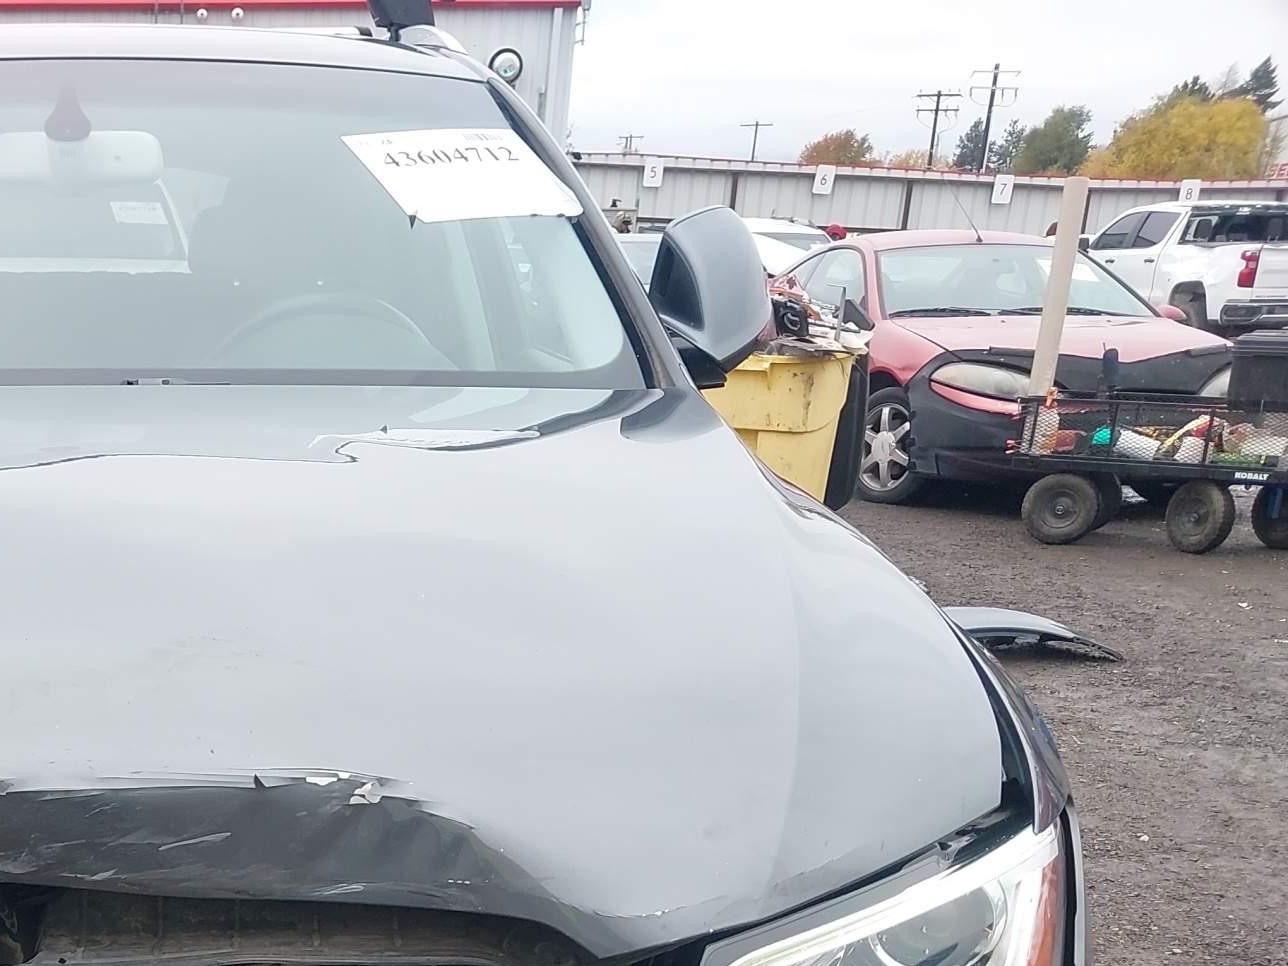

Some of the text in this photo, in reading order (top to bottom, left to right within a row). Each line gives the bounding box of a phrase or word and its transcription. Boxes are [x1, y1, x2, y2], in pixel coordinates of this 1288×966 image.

[384, 147, 519, 167] 43604712
[649, 166, 657, 179] 5
[820, 174, 828, 186] 6
[999, 183, 1008, 196] 7
[1185, 187, 1193, 200] 8
[1234, 472, 1269, 480] KOBALT
